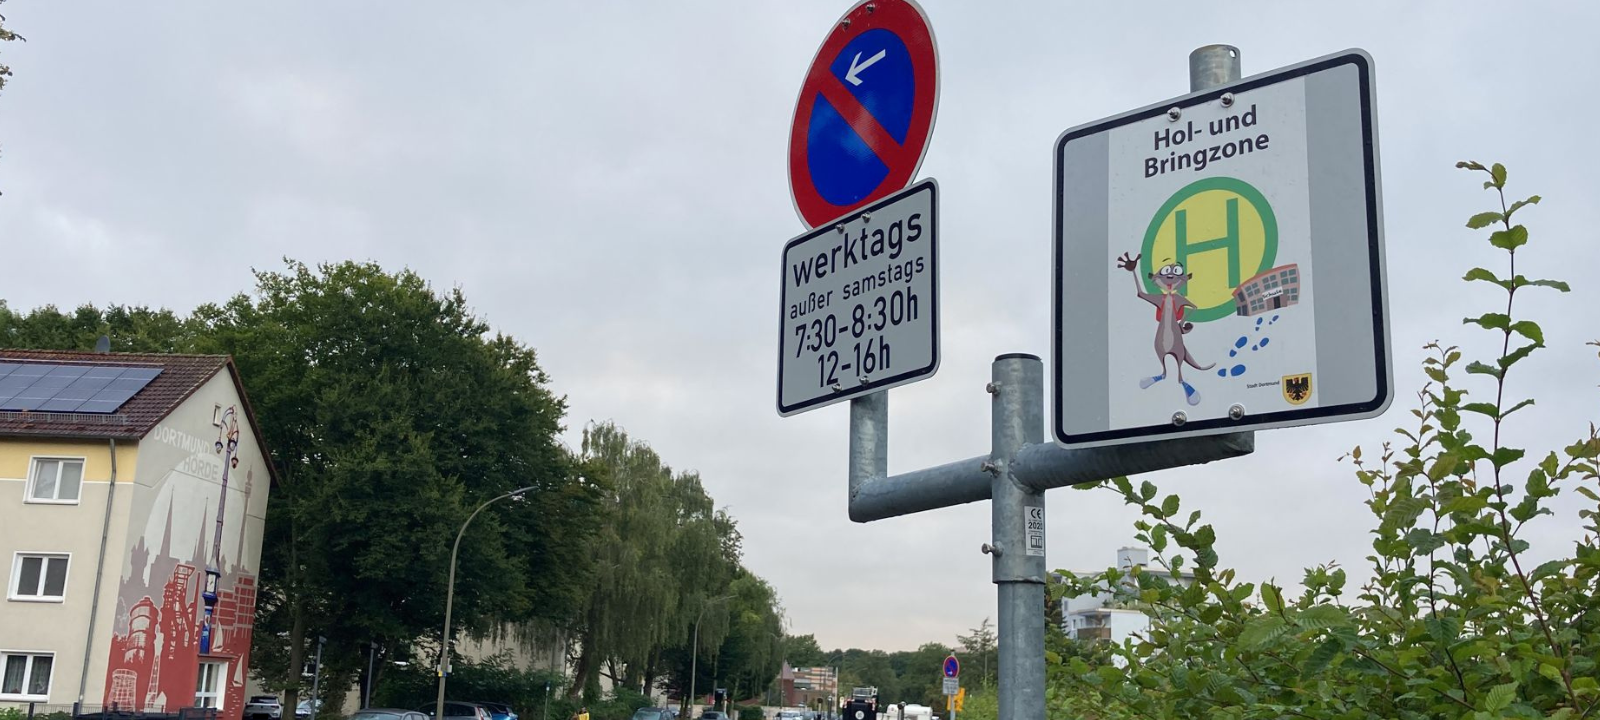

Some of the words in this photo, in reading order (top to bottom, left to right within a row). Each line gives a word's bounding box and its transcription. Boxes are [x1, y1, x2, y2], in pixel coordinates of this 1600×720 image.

[1154, 121, 1202, 150] Hol-
[1209, 104, 1257, 136] und
[1144, 133, 1270, 178] Bringzone
[793, 213, 922, 287] werktags
[1175, 198, 1240, 297] H
[790, 289, 833, 319] außer
[843, 256, 925, 300] samstags
[818, 335, 890, 388] 12-16h
[154, 425, 210, 454] DORTMUND
[1030, 508, 1041, 519] CE
